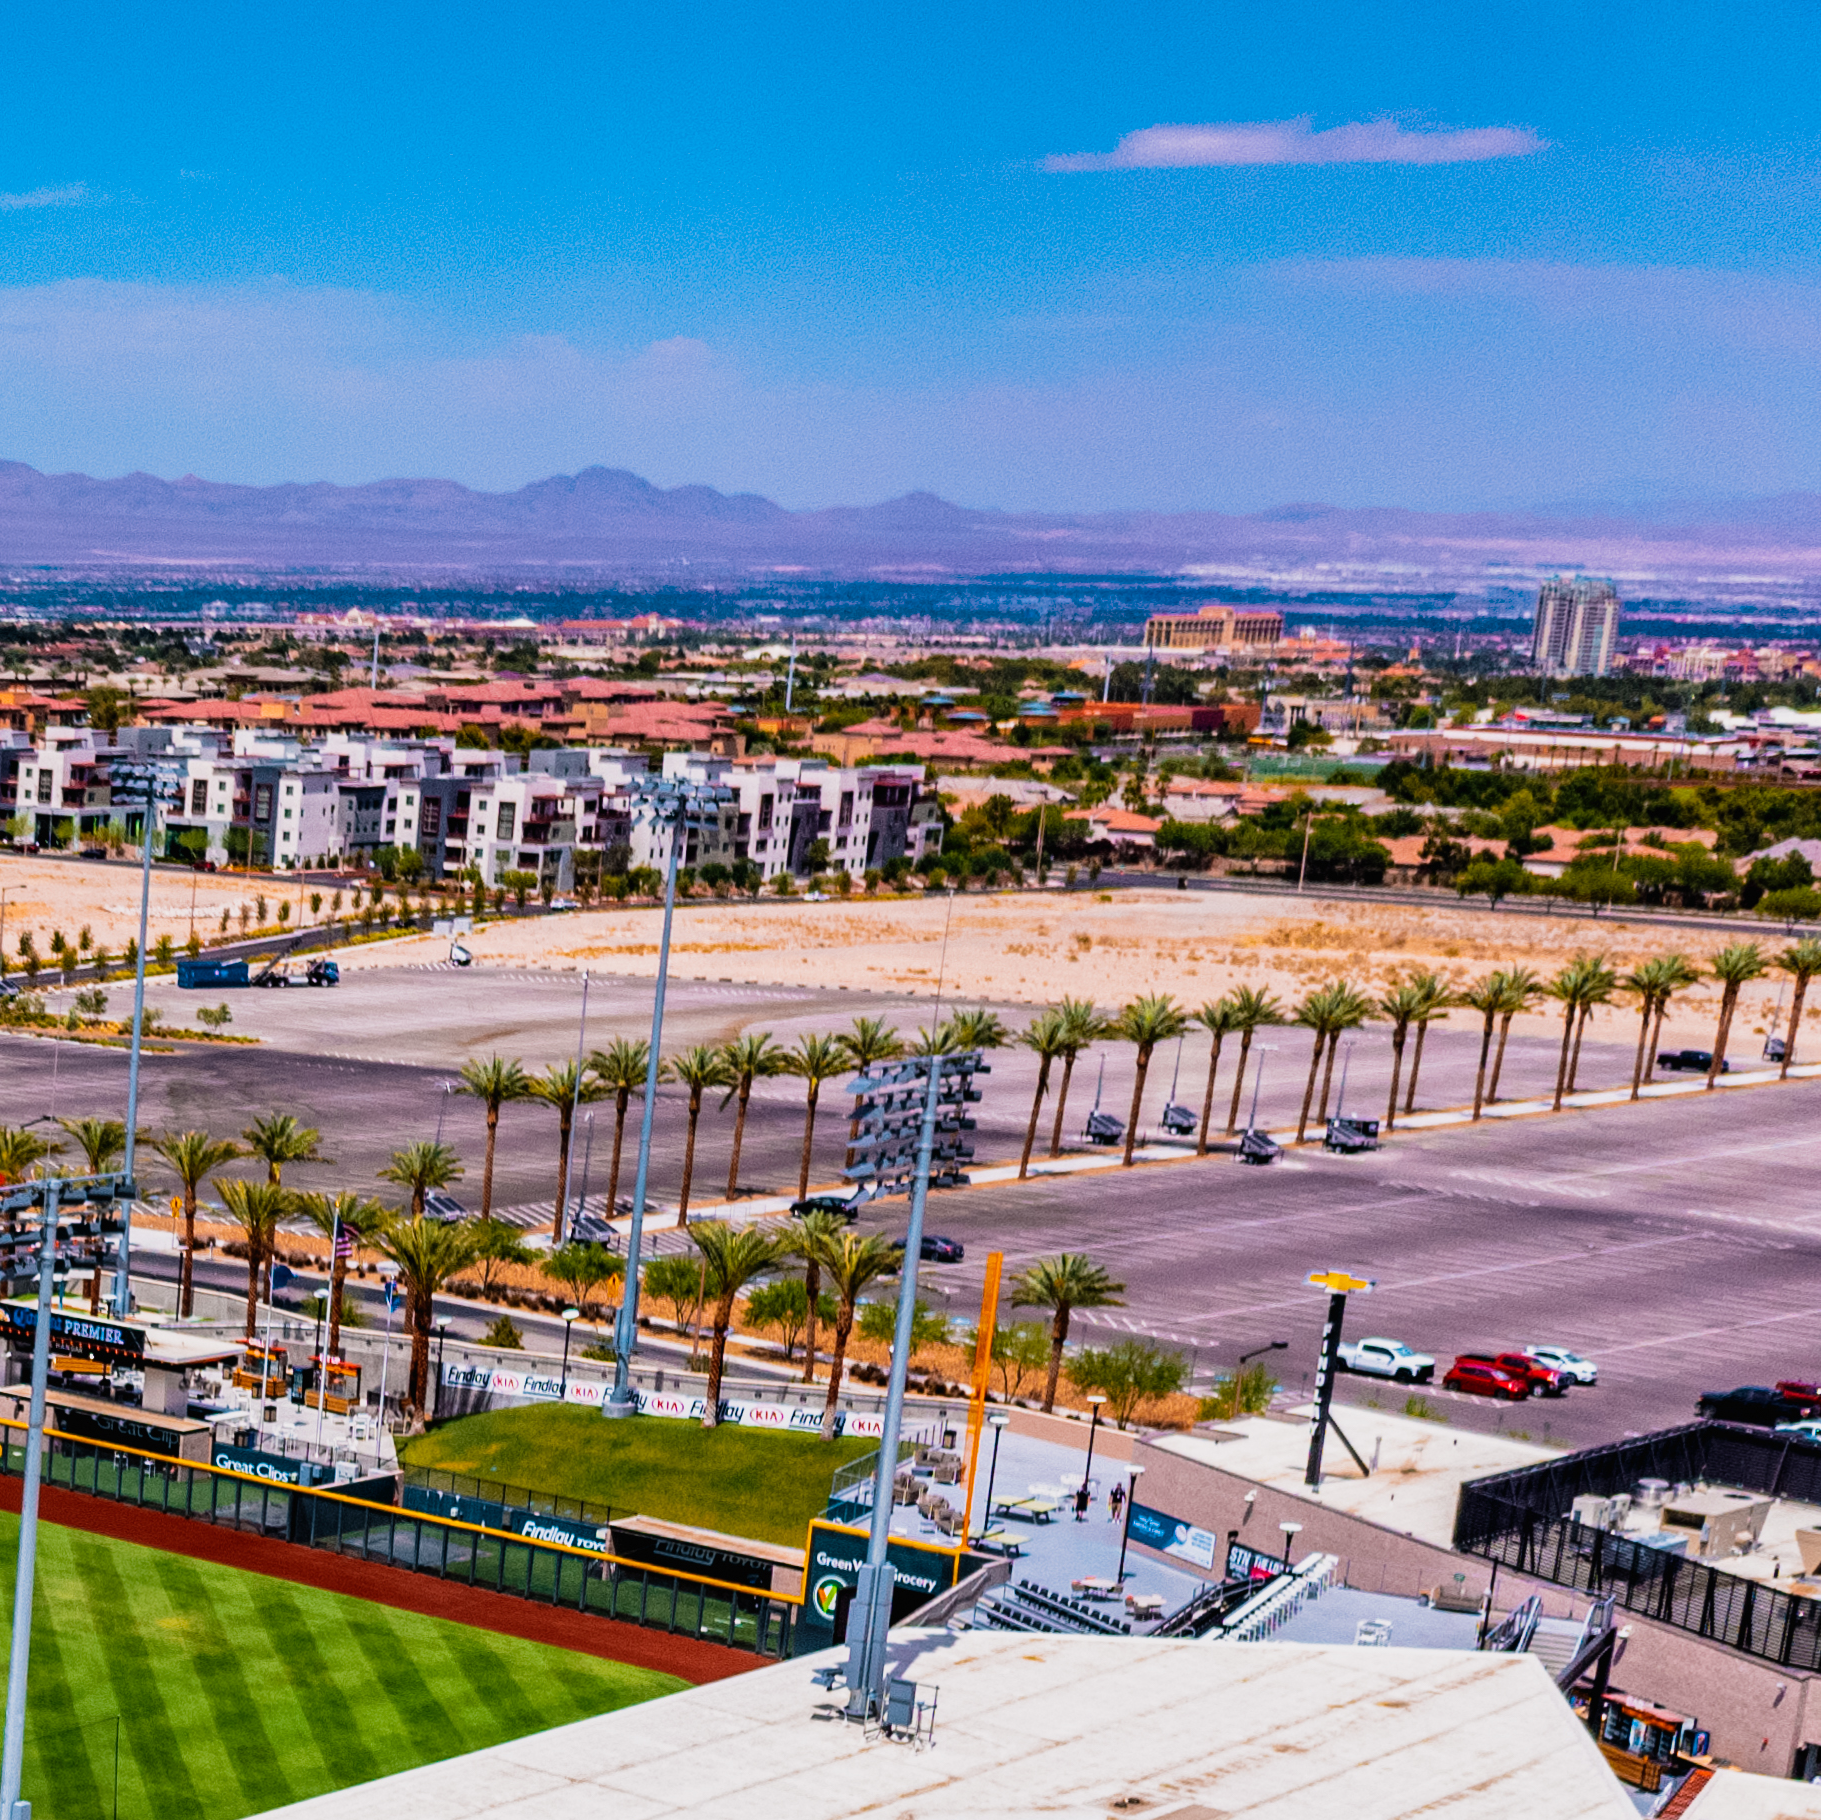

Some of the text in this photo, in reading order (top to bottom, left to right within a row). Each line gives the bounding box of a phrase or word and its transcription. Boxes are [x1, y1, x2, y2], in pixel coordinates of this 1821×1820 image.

[65, 1319, 124, 1345] PREMIER
[448, 1367, 490, 1388] Findlay
[858, 1419, 881, 1432] KIA
[216, 1453, 288, 1483] Great Clips
[522, 1521, 574, 1547] Findlay
[893, 1569, 937, 1594] rocery
